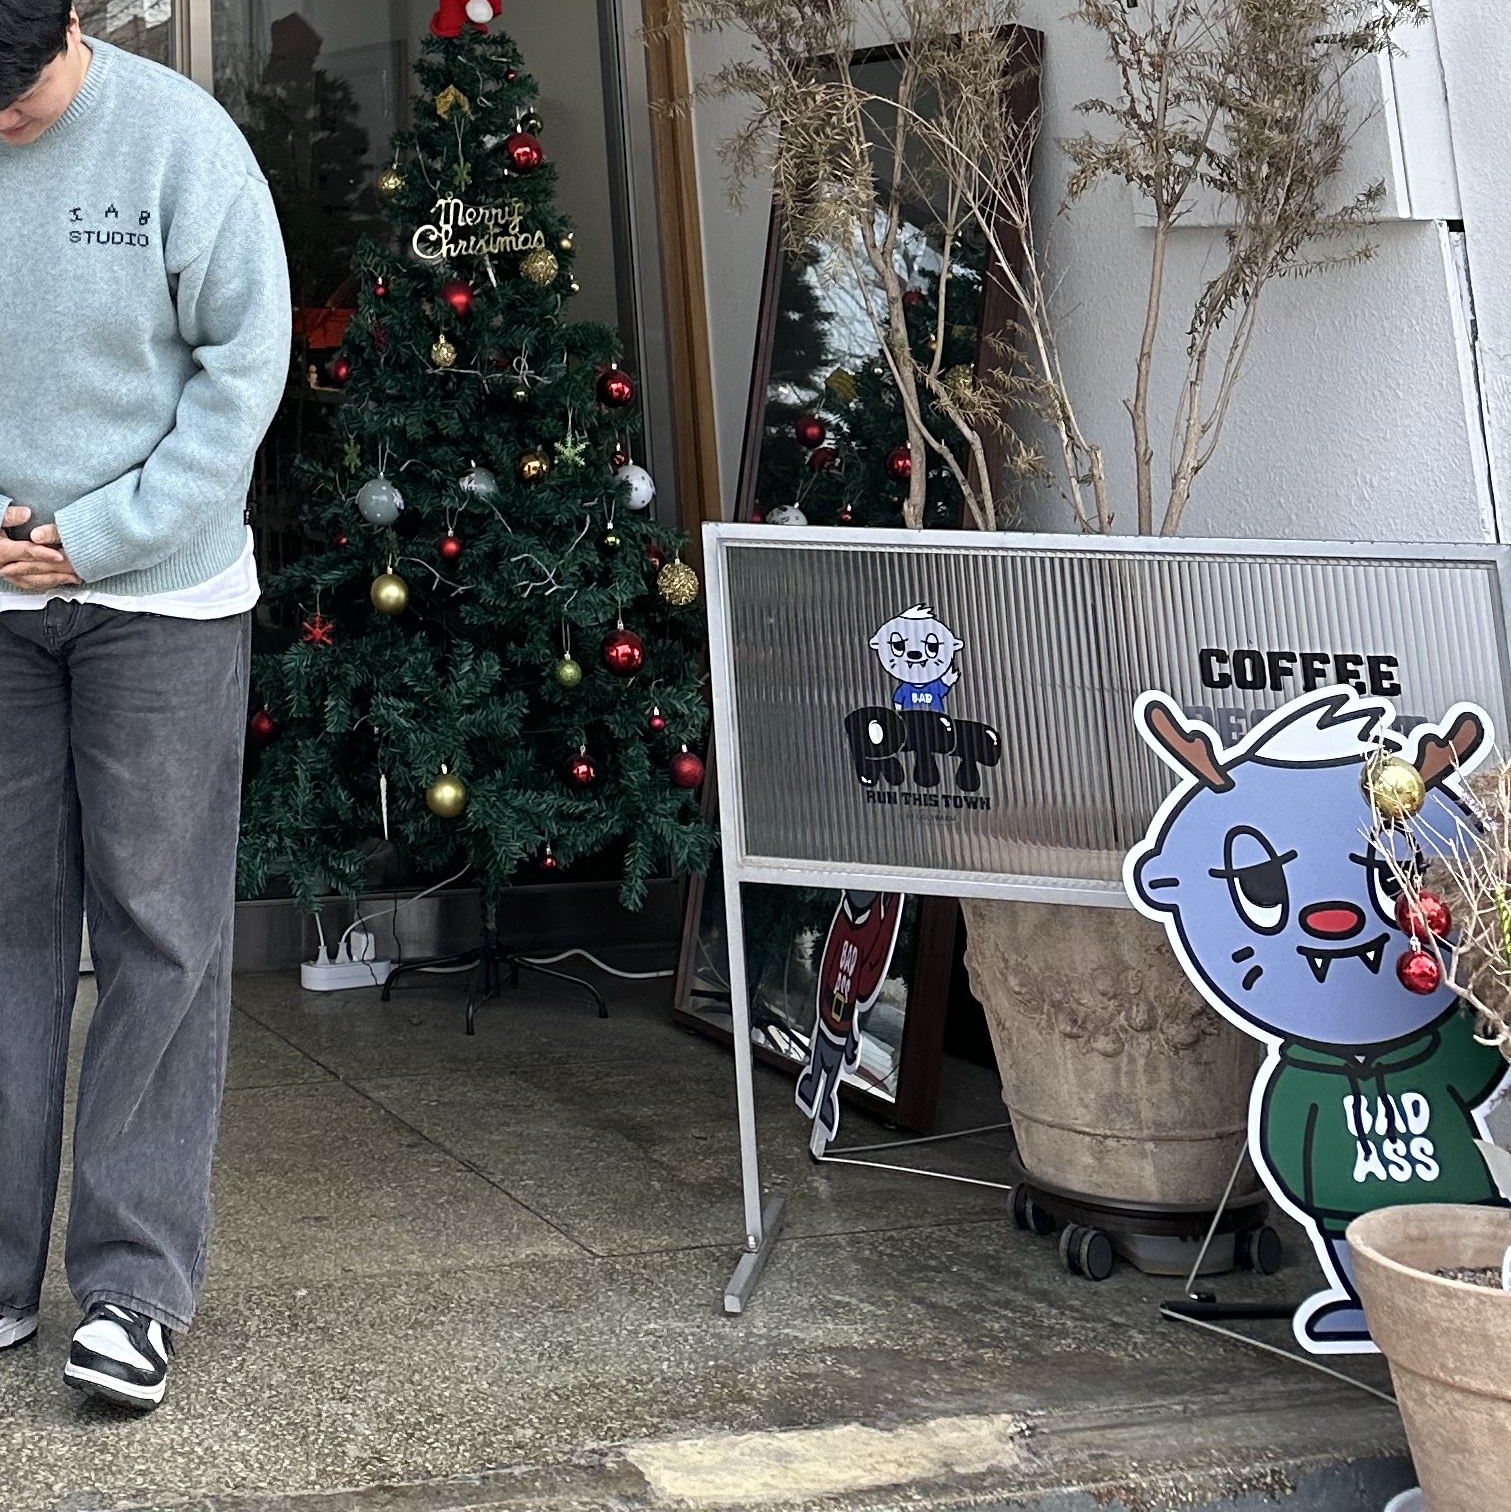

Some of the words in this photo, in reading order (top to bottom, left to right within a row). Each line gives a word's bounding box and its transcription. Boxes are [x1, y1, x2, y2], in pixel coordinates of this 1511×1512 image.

[430, 197, 524, 235] Merry
[68, 230, 149, 248] STUDIO
[412, 224, 546, 259] Christmas
[1198, 647, 1402, 697] COFFEE
[866, 789, 898, 805] RUN
[901, 791, 940, 808] THIS
[941, 793, 992, 811] TOWN
[1352, 1136, 1440, 1183] ASS
